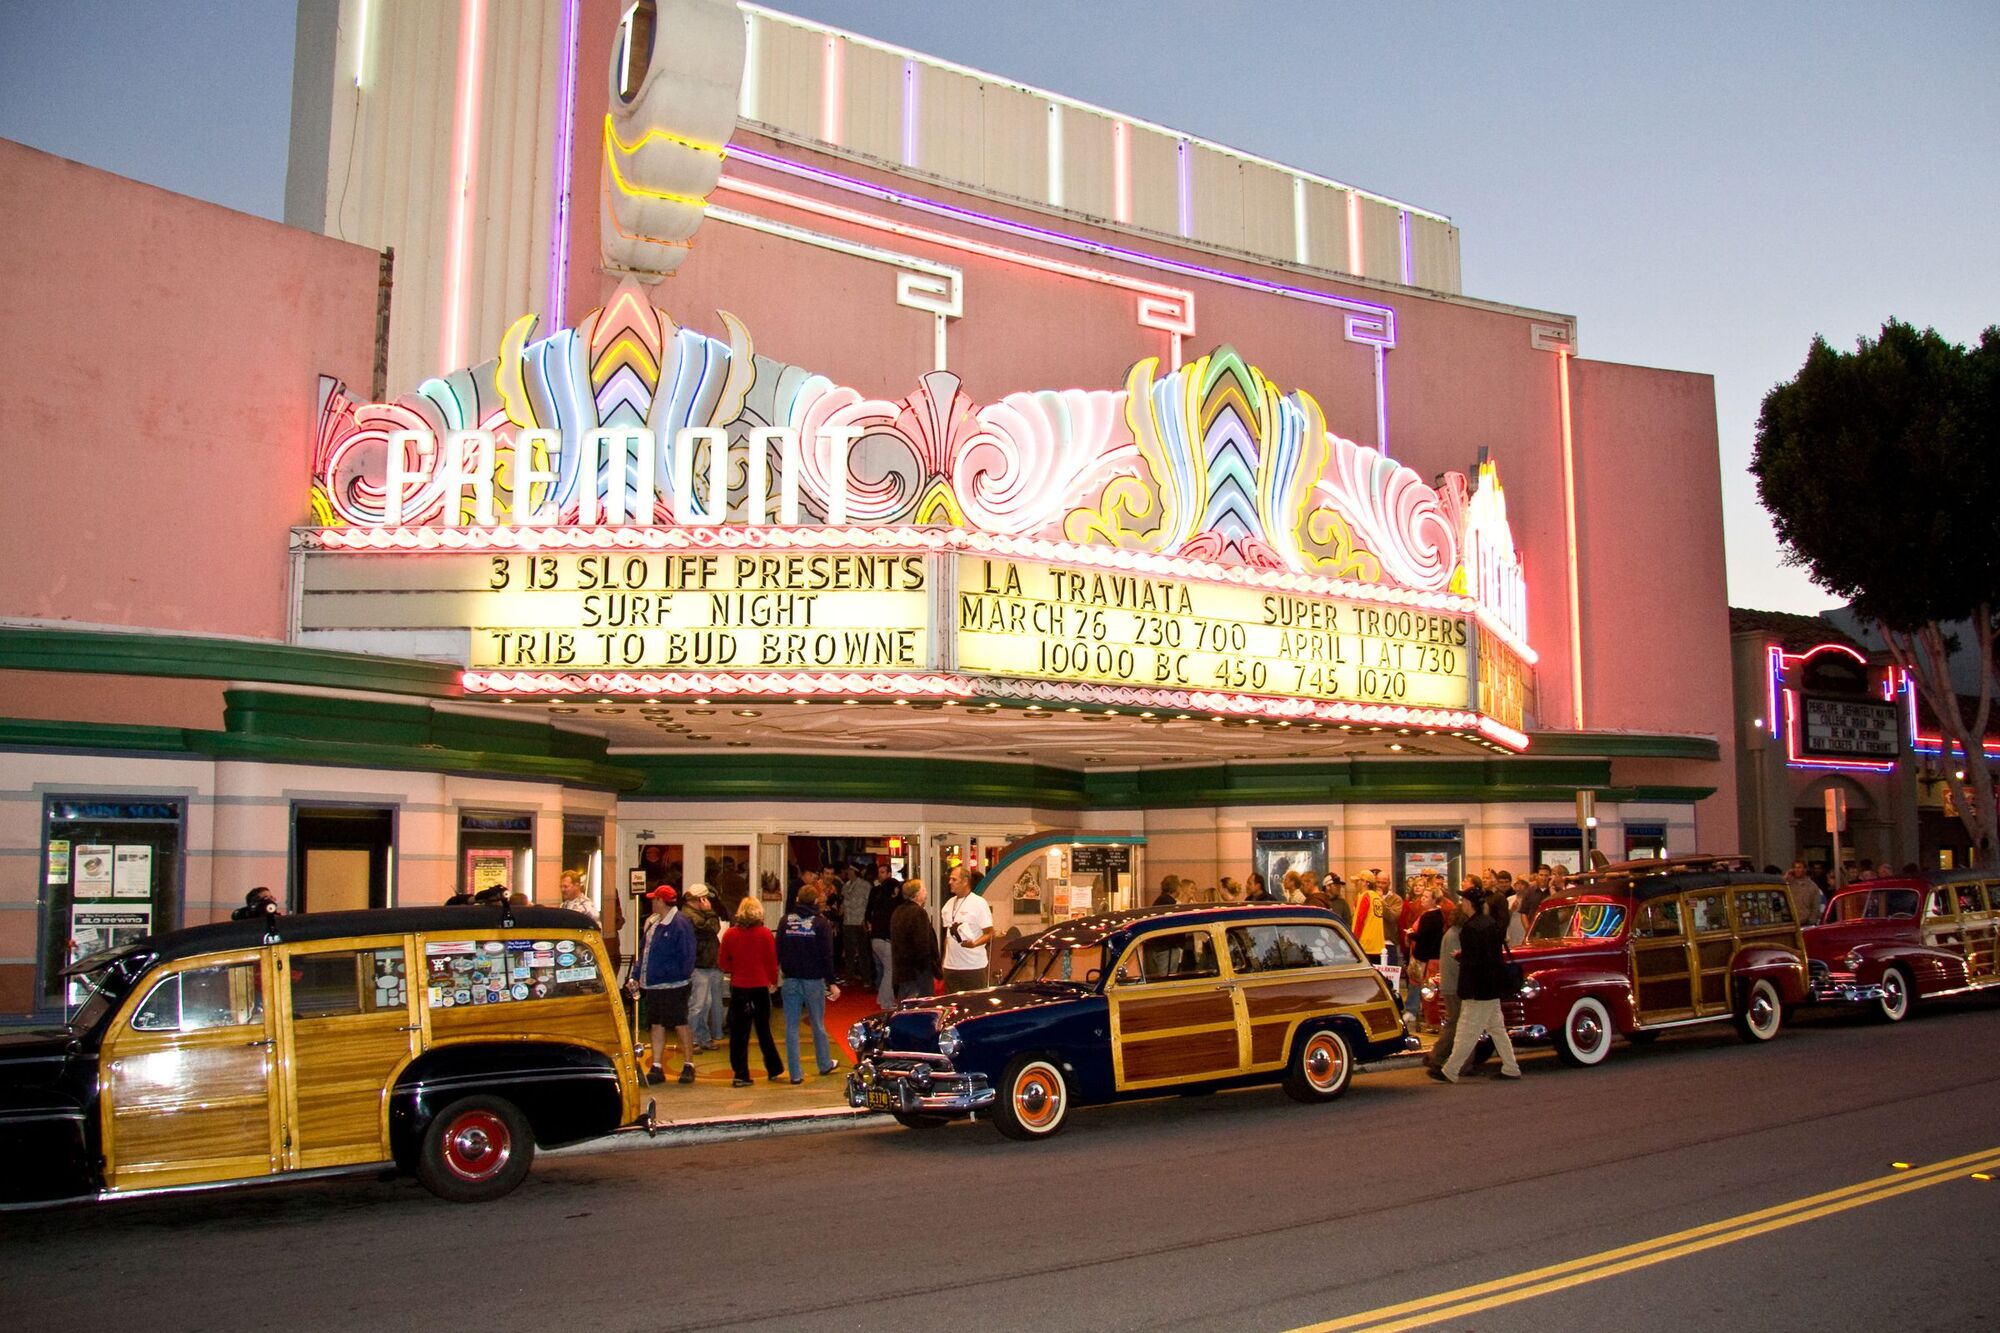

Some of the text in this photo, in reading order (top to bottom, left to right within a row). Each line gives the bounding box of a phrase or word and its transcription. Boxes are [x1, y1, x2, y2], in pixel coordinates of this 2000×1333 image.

[384, 426, 864, 526] FREMONT
[490, 555, 924, 589] 3 13 SLO IFF PRESENTS
[983, 560, 1193, 614] LA TRAVIATA
[582, 593, 818, 627] SURF NIGHT
[960, 594, 1246, 652] MARCH 26 230 700
[1264, 596, 1466, 645] SUPER TROOPERS
[492, 631, 916, 665] TRIB TO BUD BROWNE
[1039, 641, 1405, 699] 10000 BC 450 745 1020
[1278, 630, 1455, 674] APRIL 1 AT 730
[1820, 714, 1846, 726] COLLEGE
